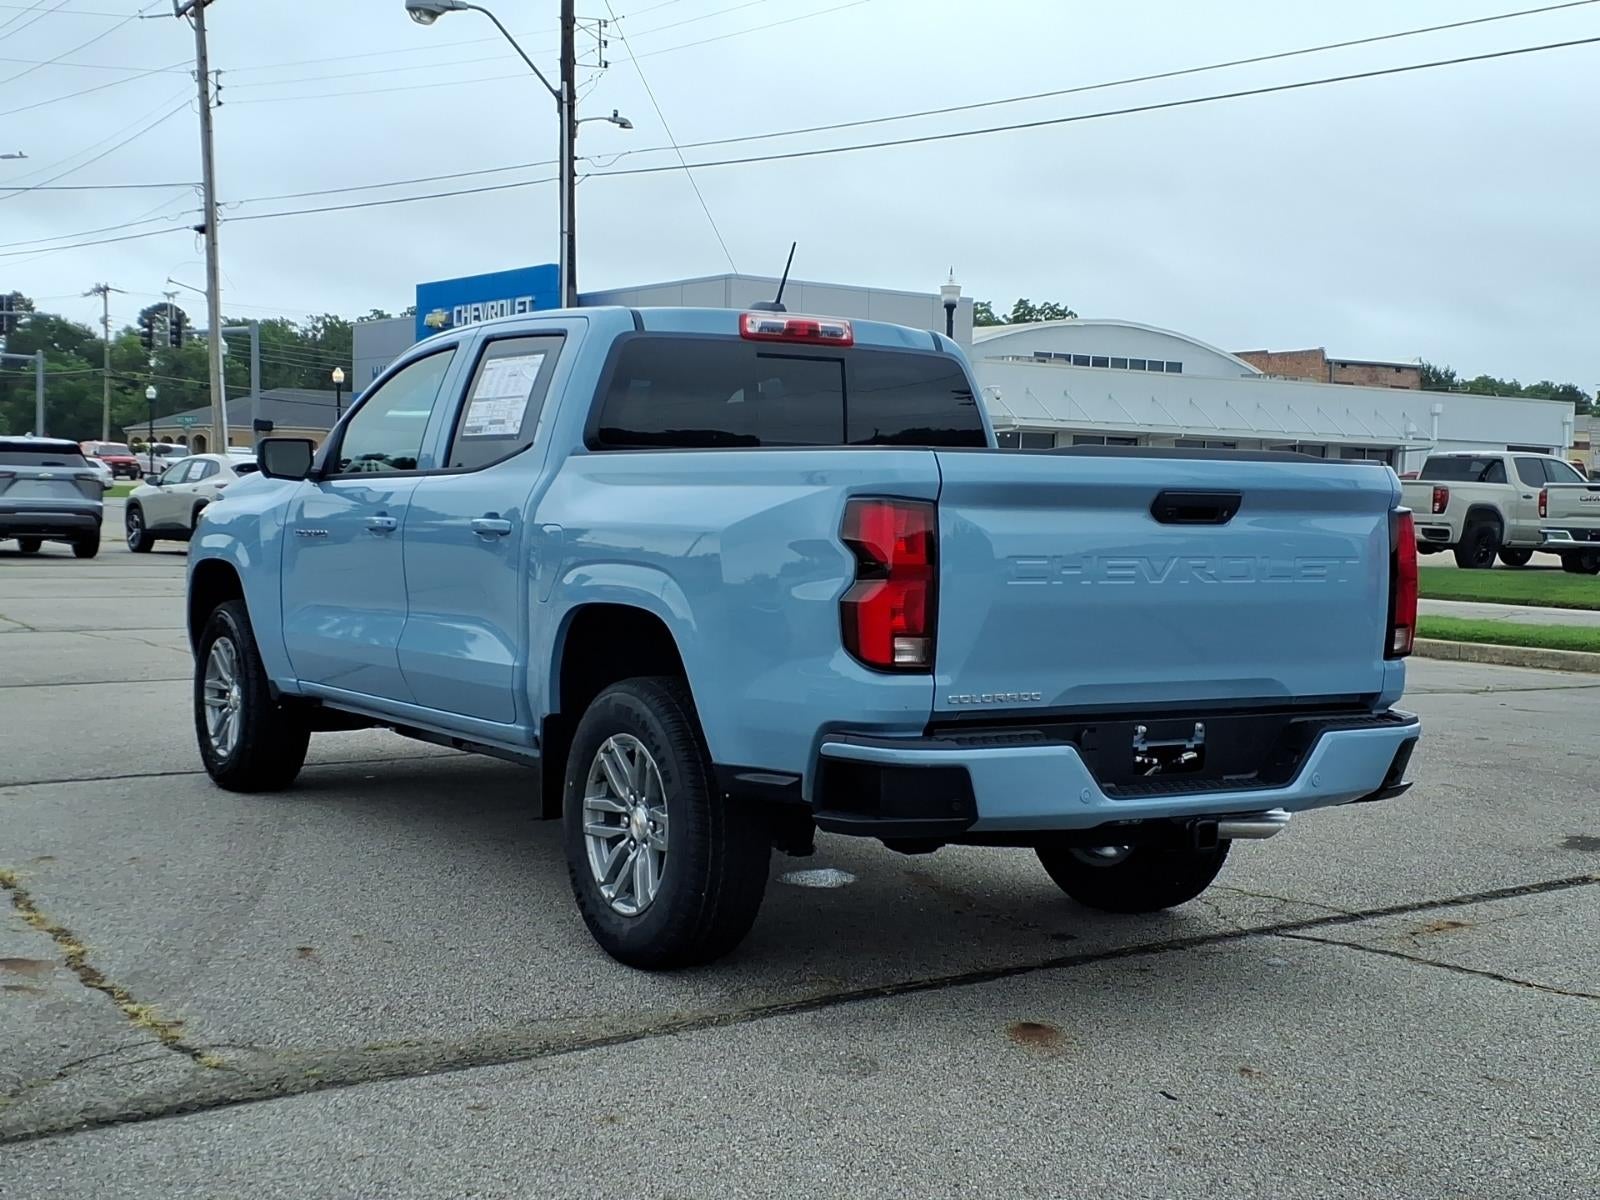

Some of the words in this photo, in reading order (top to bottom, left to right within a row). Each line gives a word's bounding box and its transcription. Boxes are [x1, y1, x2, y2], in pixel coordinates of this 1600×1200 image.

[453, 296, 534, 327] CHEVROLET
[1007, 555, 1360, 584] CHEVROLET
[948, 692, 1041, 704] COLORADO
